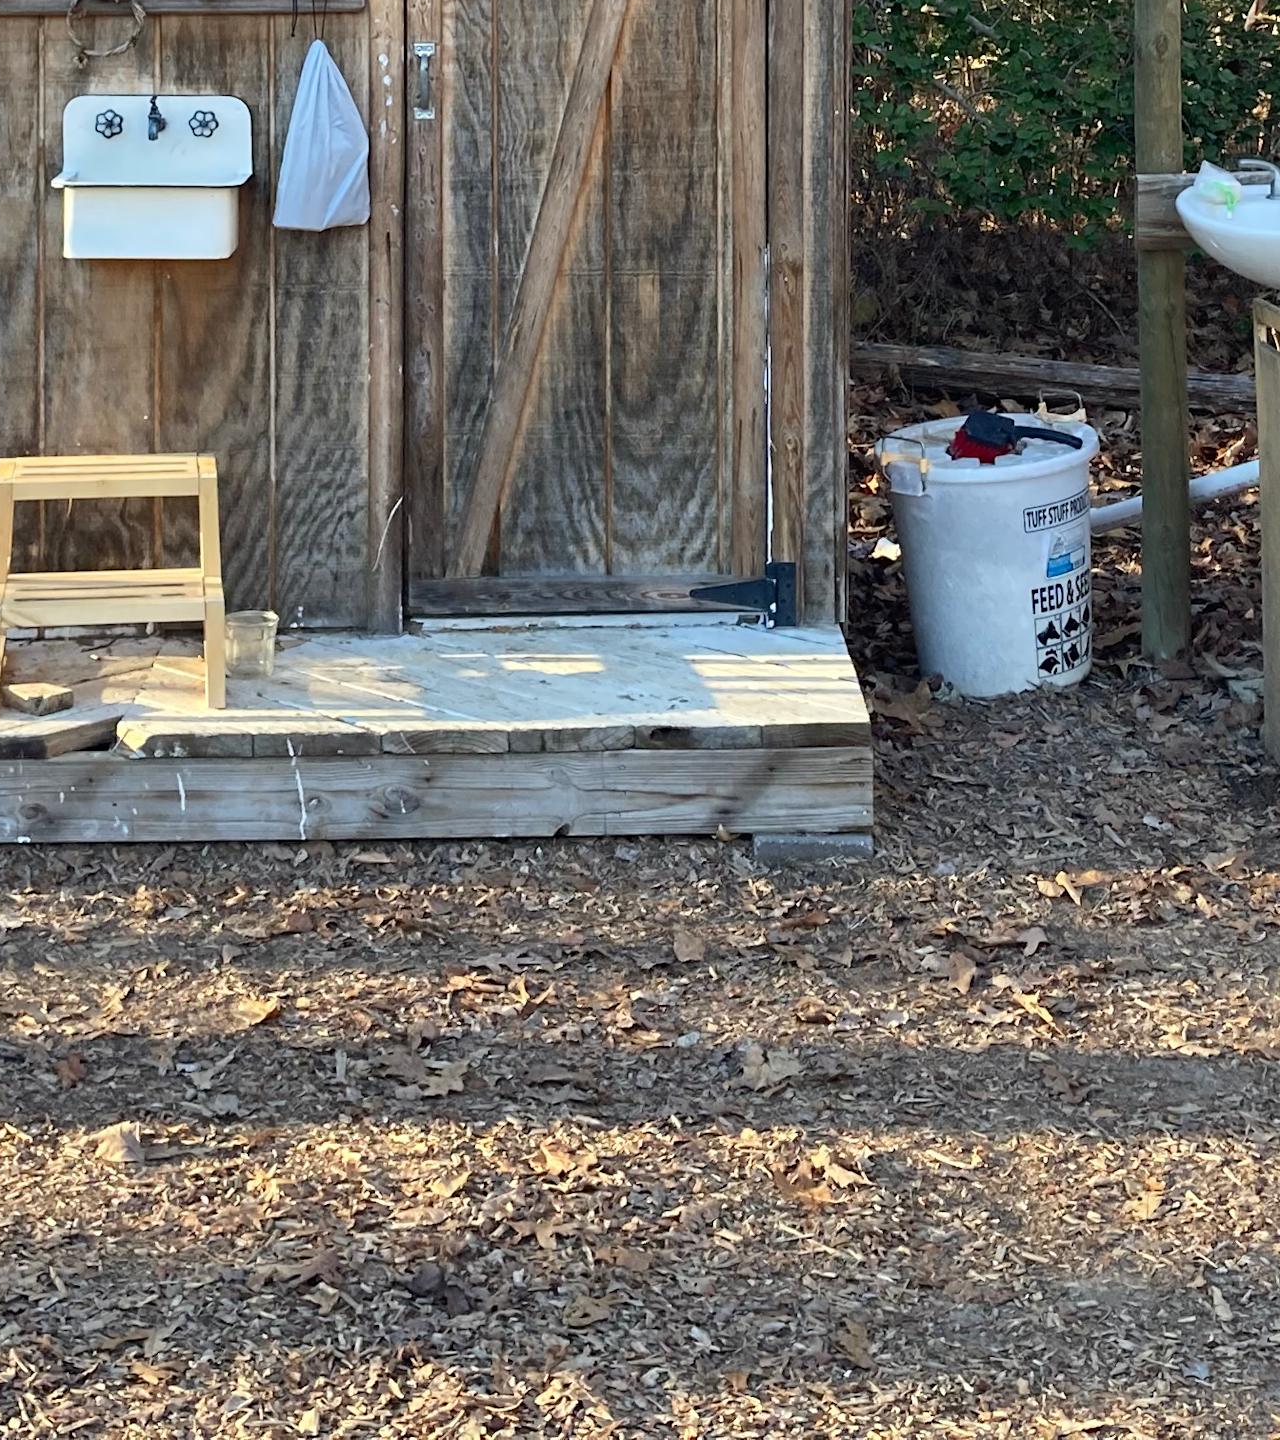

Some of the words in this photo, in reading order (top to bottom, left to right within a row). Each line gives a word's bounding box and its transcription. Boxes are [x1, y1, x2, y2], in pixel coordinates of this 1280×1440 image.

[1026, 508, 1047, 529] TUFF
[1048, 502, 1069, 525] STUFF
[1031, 583, 1064, 615] FEED
[1066, 579, 1074, 605] &
